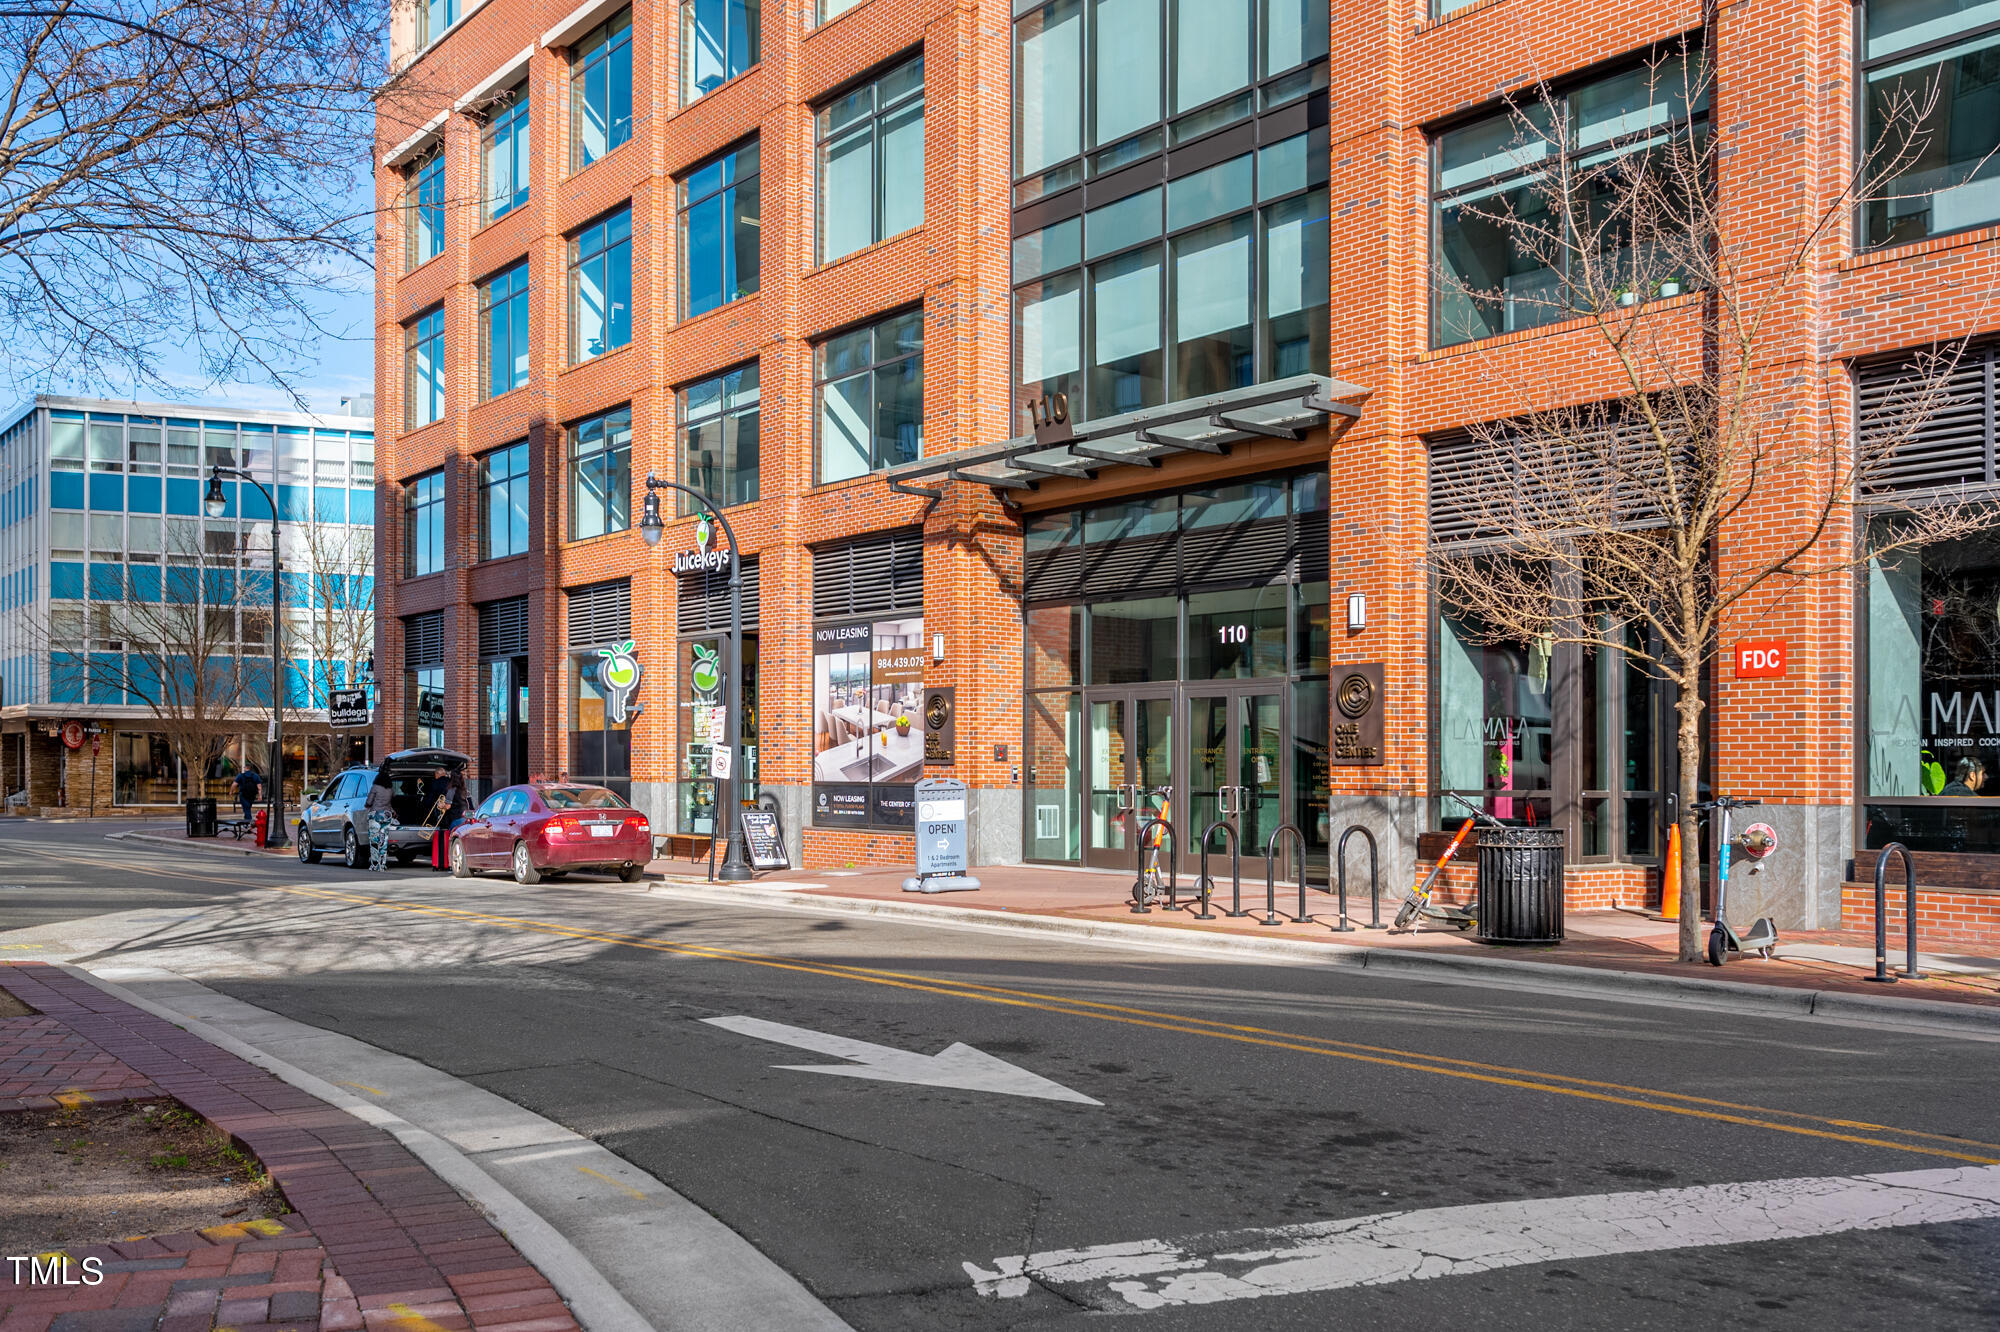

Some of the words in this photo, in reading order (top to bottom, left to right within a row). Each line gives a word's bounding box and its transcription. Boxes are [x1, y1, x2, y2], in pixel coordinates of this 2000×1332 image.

[1027, 392, 1068, 425] 110
[816, 630, 836, 641] NOW
[836, 626, 869, 640] LEASING
[1218, 625, 1246, 643] 110
[1742, 649, 1780, 669] FDC
[1335, 722, 1359, 734] ONE
[1480, 717, 1530, 740] MALA
[1335, 735, 1360, 746] CITY
[1934, 738, 1974, 747] INSPIRED
[1335, 746, 1377, 758] CENTER
[845, 795, 865, 803] LEASING
[928, 823, 957, 835] OPEN!
